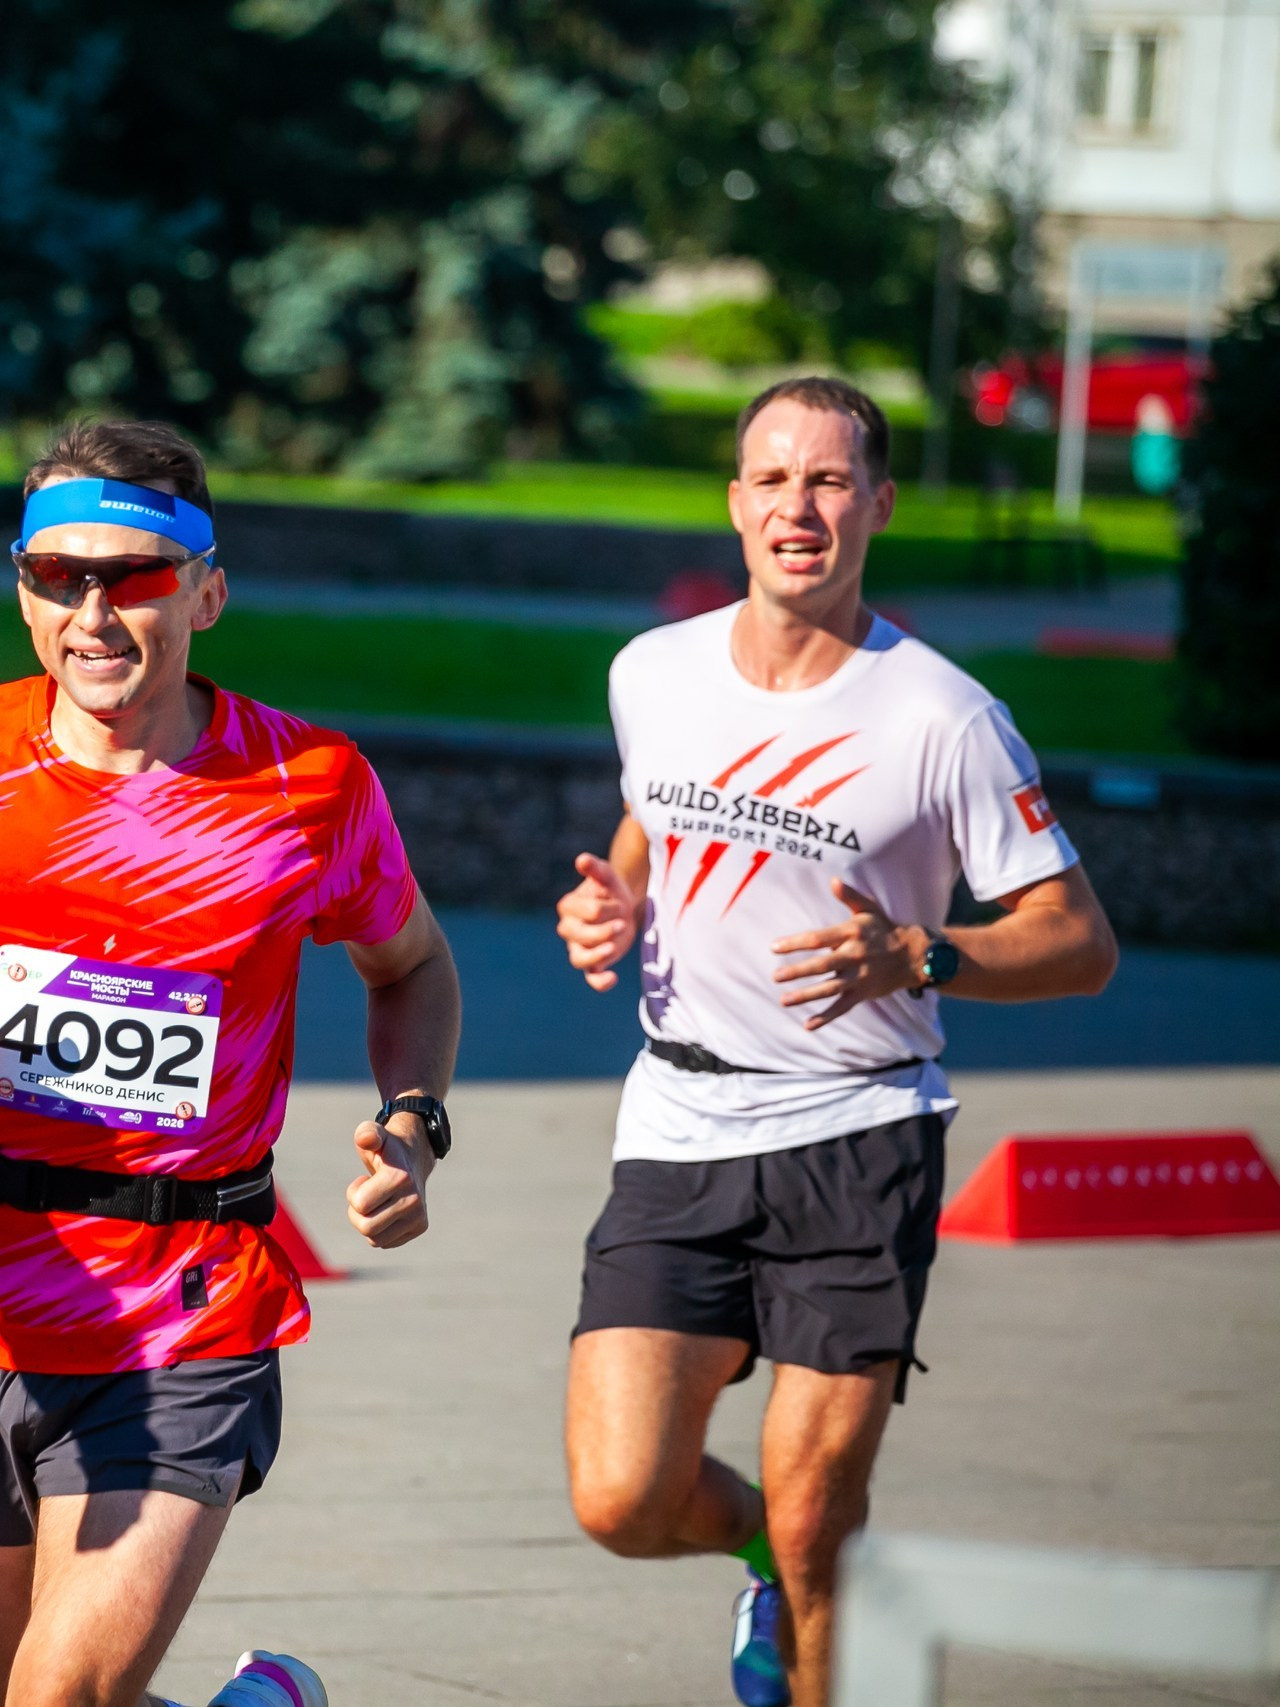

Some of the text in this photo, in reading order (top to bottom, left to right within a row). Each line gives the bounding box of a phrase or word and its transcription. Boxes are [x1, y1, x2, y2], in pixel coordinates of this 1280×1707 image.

[774, 834, 823, 862] 2024
[69, 969, 154, 991] КРАСНОЯРСКИЕ
[90, 982, 130, 997] МОСТЫ
[91, 992, 127, 1004] МАРАФОН
[19, 1070, 166, 1104] СЕРЕЖНИКОВ ДЕНИС
[156, 1116, 185, 1129] 2026
